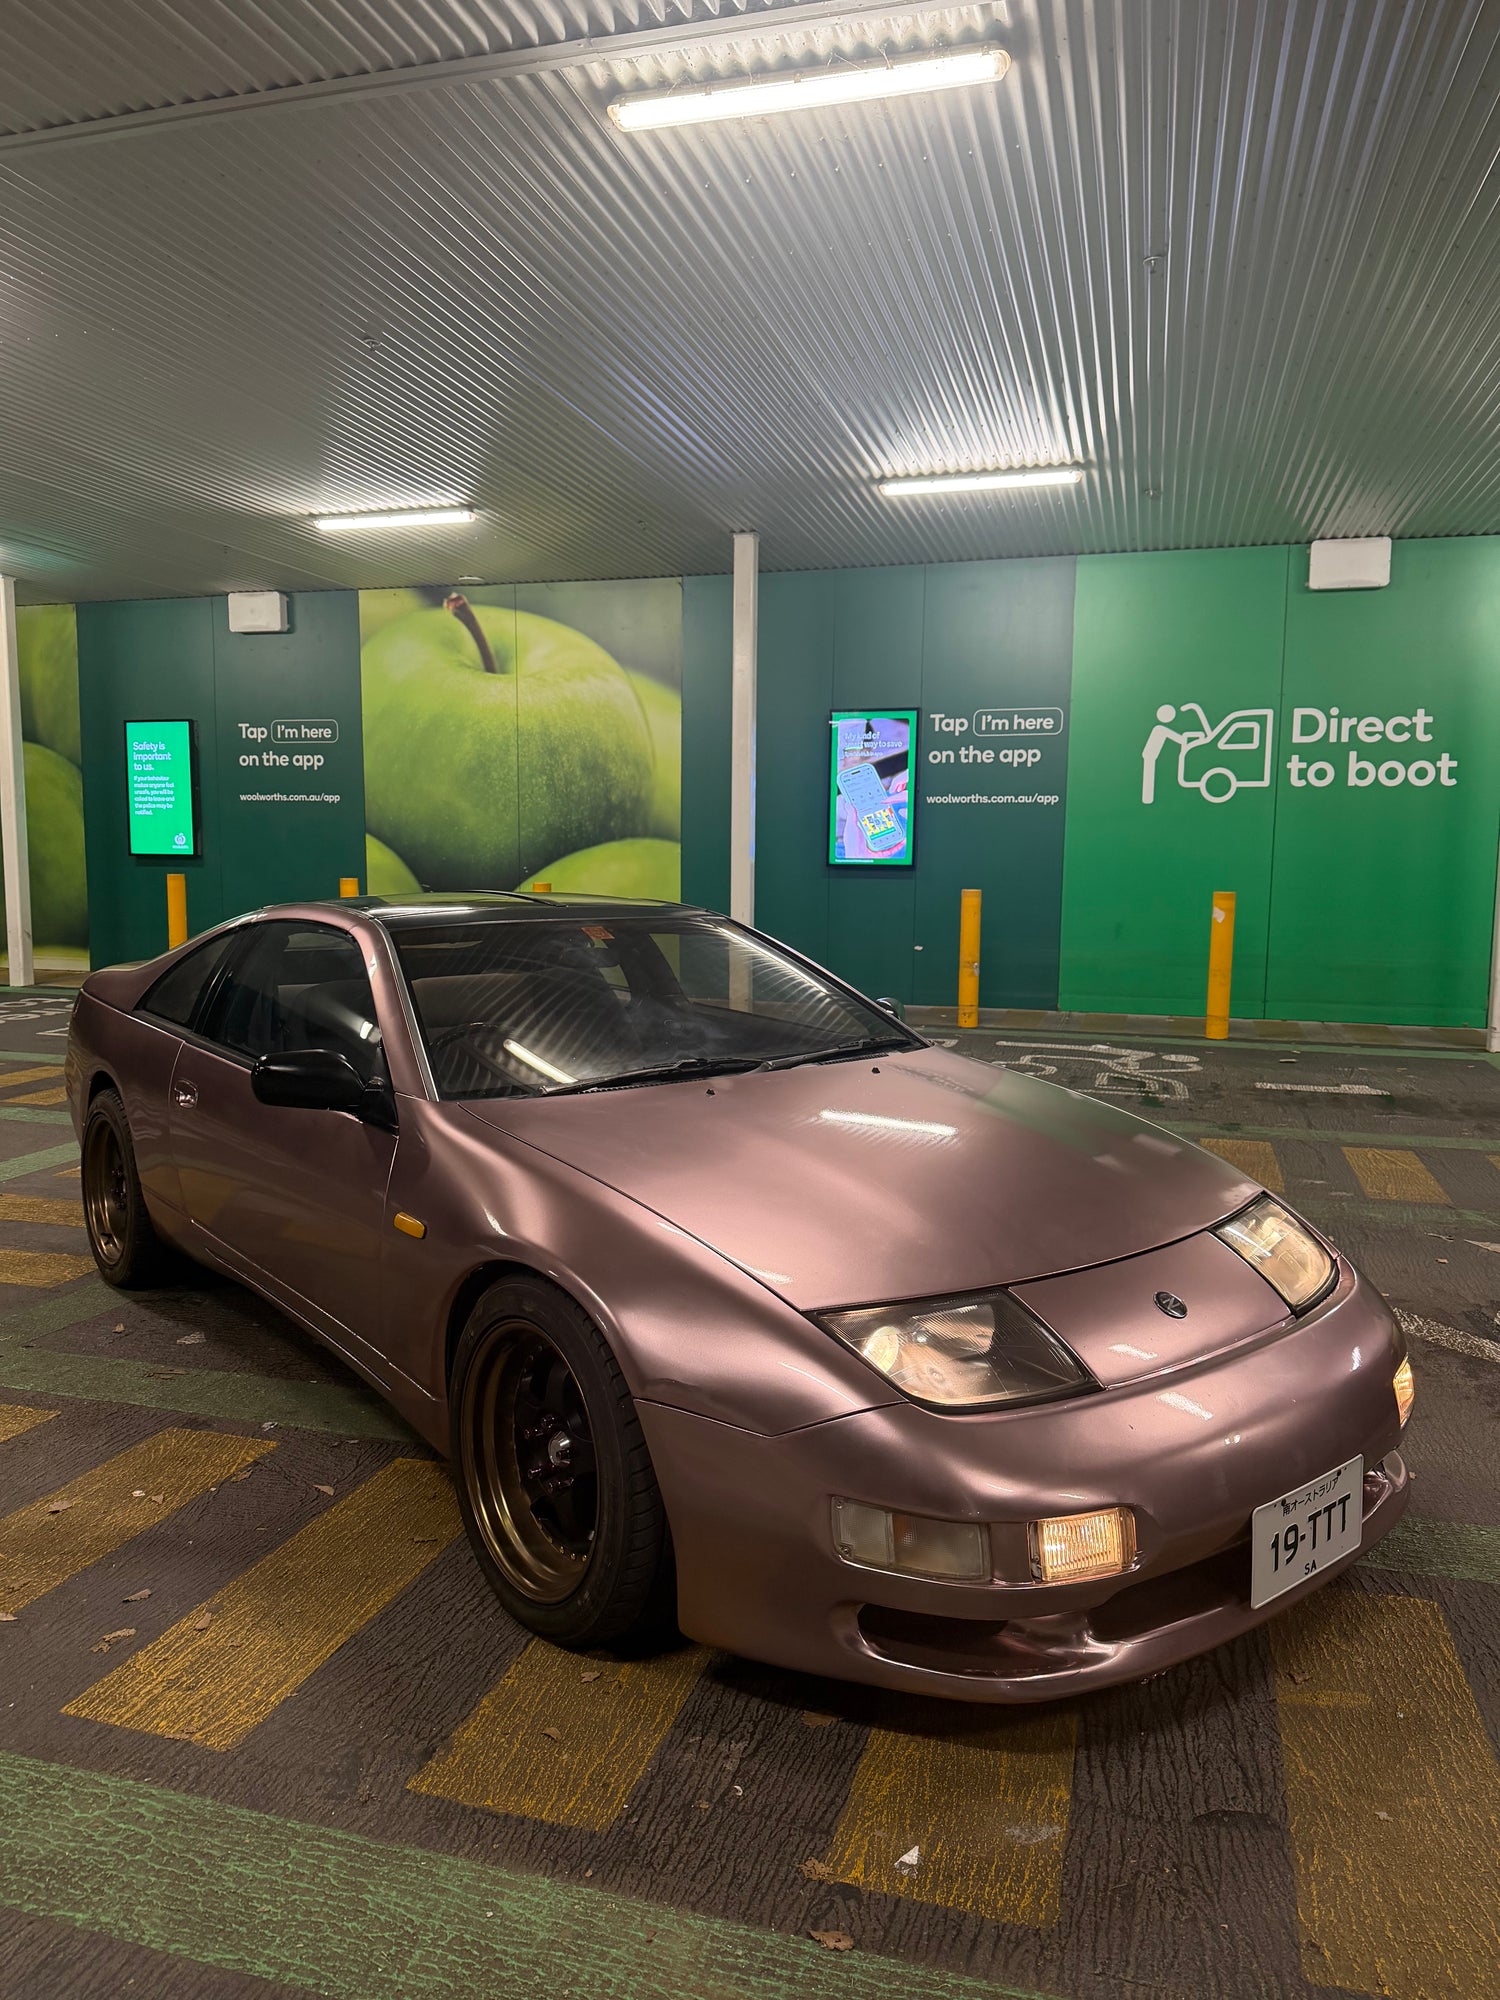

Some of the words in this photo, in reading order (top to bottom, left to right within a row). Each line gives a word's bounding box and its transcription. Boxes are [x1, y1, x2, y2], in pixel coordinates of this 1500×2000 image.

[238, 723, 268, 743] Tap
[277, 725, 299, 739] I'm
[301, 724, 332, 739] here
[929, 713, 969, 737] Tap
[981, 714, 1010, 732] I'm
[1013, 711, 1055, 730] here
[1291, 706, 1434, 744] Direct
[133, 741, 158, 753] Safety
[158, 741, 166, 751] is
[928, 750, 955, 764] on
[958, 745, 995, 764] the
[999, 748, 1042, 767] app
[133, 751, 172, 763] important
[239, 753, 259, 767] on
[262, 751, 290, 767] the
[292, 754, 325, 770] app
[133, 763, 142, 771] to
[1286, 754, 1336, 788] to
[1347, 750, 1458, 787] boot
[239, 792, 342, 804] woolworths.com.au/app
[926, 792, 1060, 806] woolworths.com.au/app
[1282, 1475, 1340, 1517] 南オーストラリア
[1271, 1492, 1352, 1573] 19-TTT
[1304, 1559, 1318, 1575] SA
